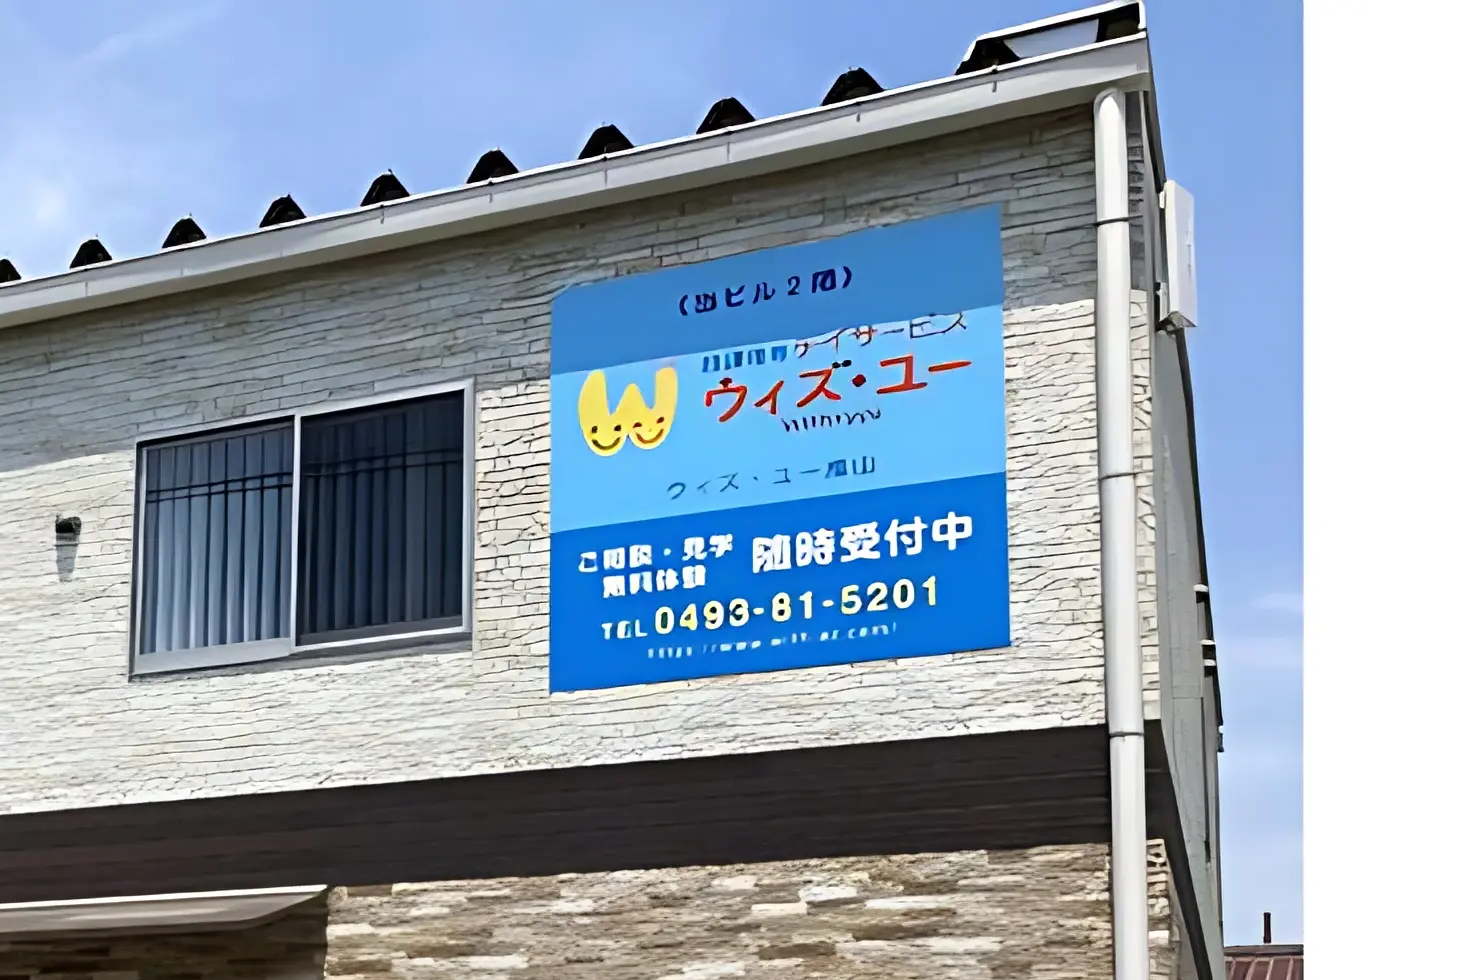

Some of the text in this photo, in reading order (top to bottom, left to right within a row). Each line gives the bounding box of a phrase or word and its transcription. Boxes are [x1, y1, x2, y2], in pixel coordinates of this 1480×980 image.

[704, 352, 973, 423] ウィズ・ユー
[752, 511, 973, 574] 随時受付中
[654, 575, 937, 635] 0493-81-5201
